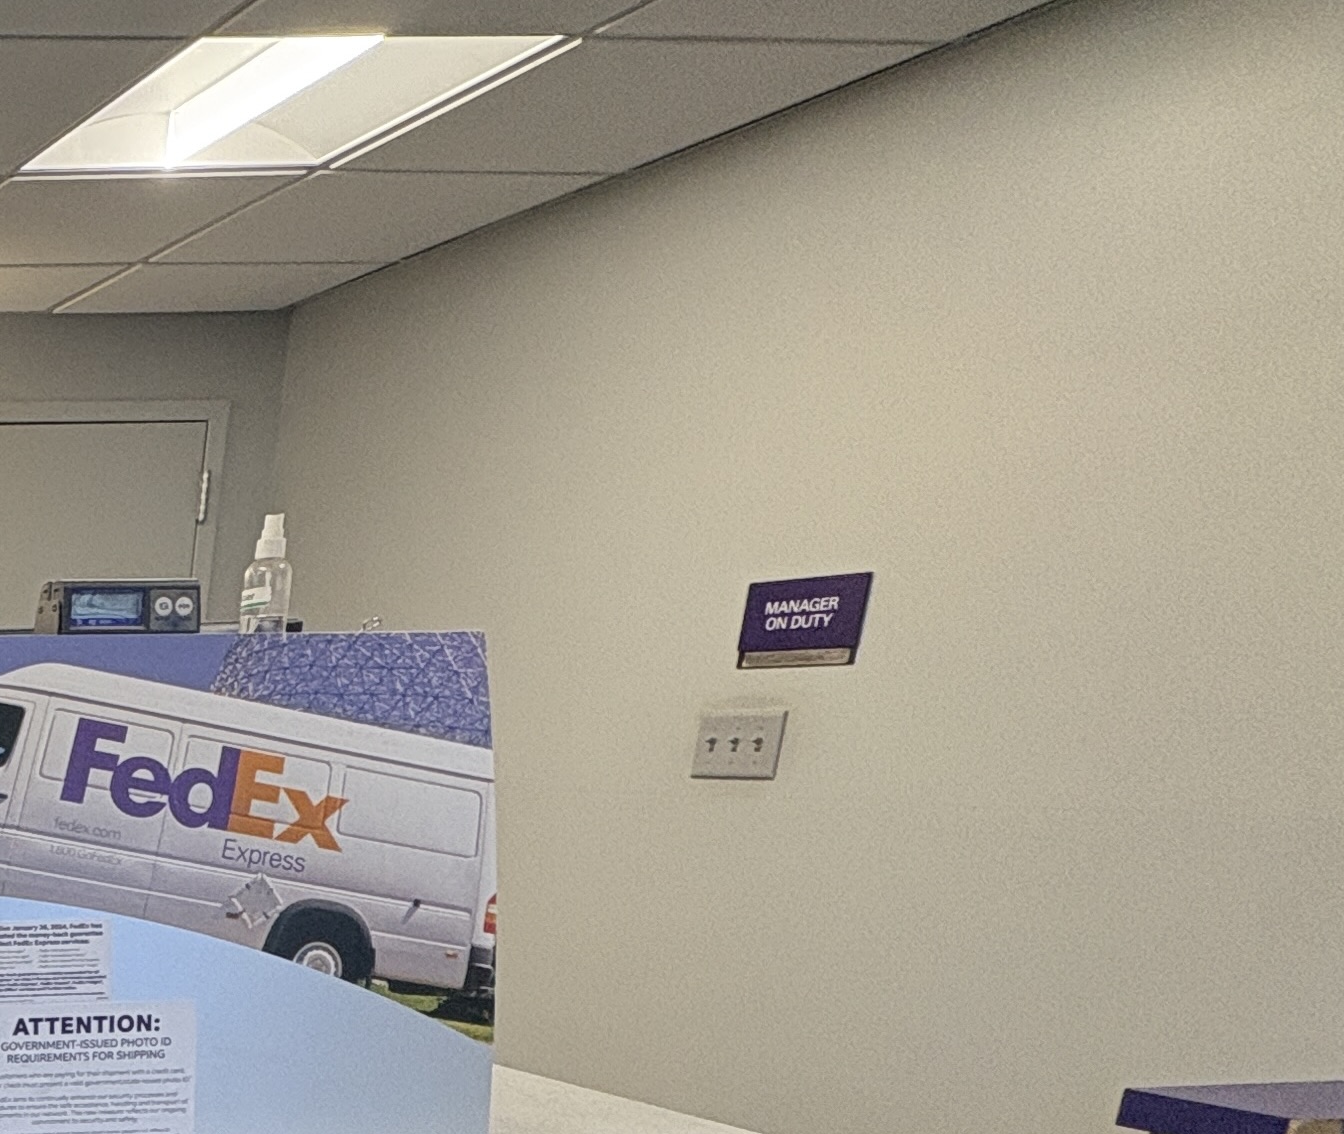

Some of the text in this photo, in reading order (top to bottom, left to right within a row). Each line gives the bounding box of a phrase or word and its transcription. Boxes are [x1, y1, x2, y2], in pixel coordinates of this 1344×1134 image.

[764, 596, 840, 615] MANAGER
[764, 613, 835, 631] ON DUTY
[59, 717, 350, 852] FedEx
[221, 838, 306, 873] Express
[12, 1014, 161, 1036] ATTENTION:
[0, 1037, 173, 1052] GOVERNMENT-ISSUED PHOTO ID
[6, 1049, 166, 1064] REQUIREMENTS FOR SHIPPING
